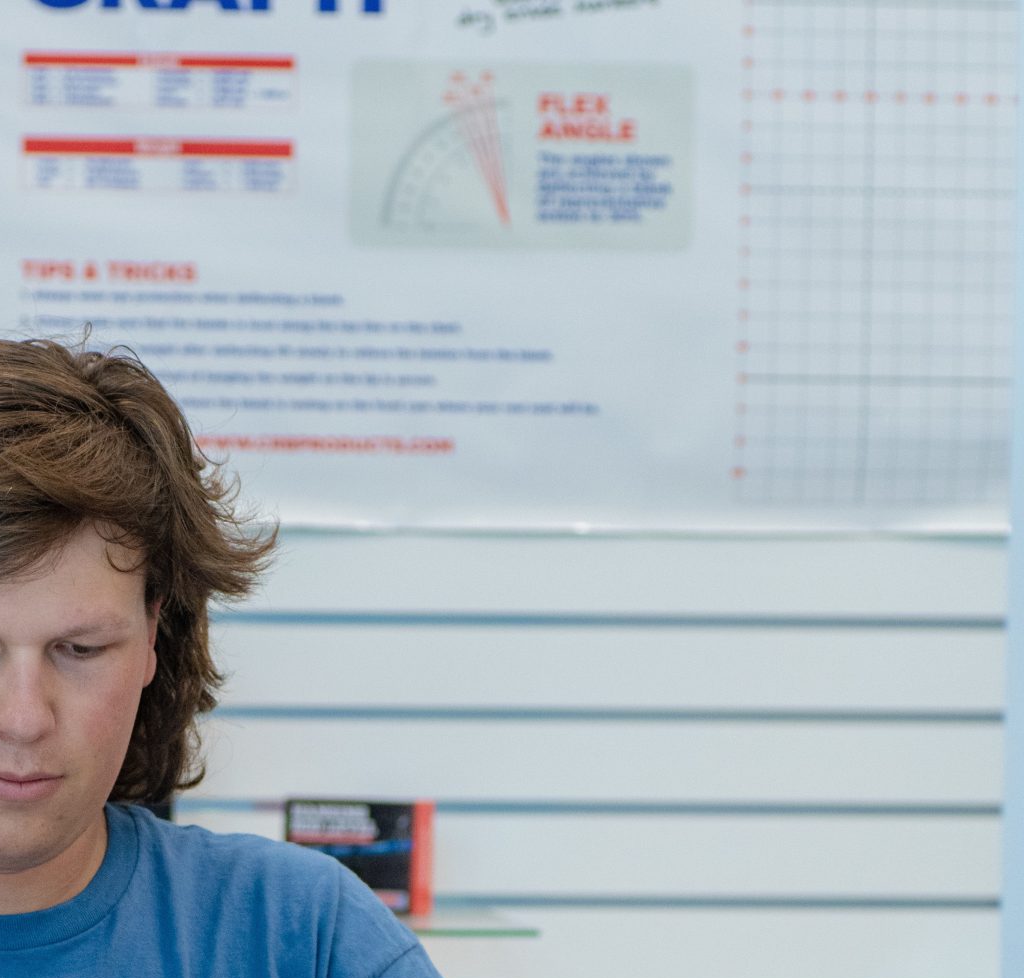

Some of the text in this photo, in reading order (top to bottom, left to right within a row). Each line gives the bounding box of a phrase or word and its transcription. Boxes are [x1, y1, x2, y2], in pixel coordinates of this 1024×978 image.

[538, 93, 609, 114] FLEX
[538, 119, 636, 142] ANGLE
[22, 260, 74, 280] TIPS
[108, 261, 198, 282] TRICKS
